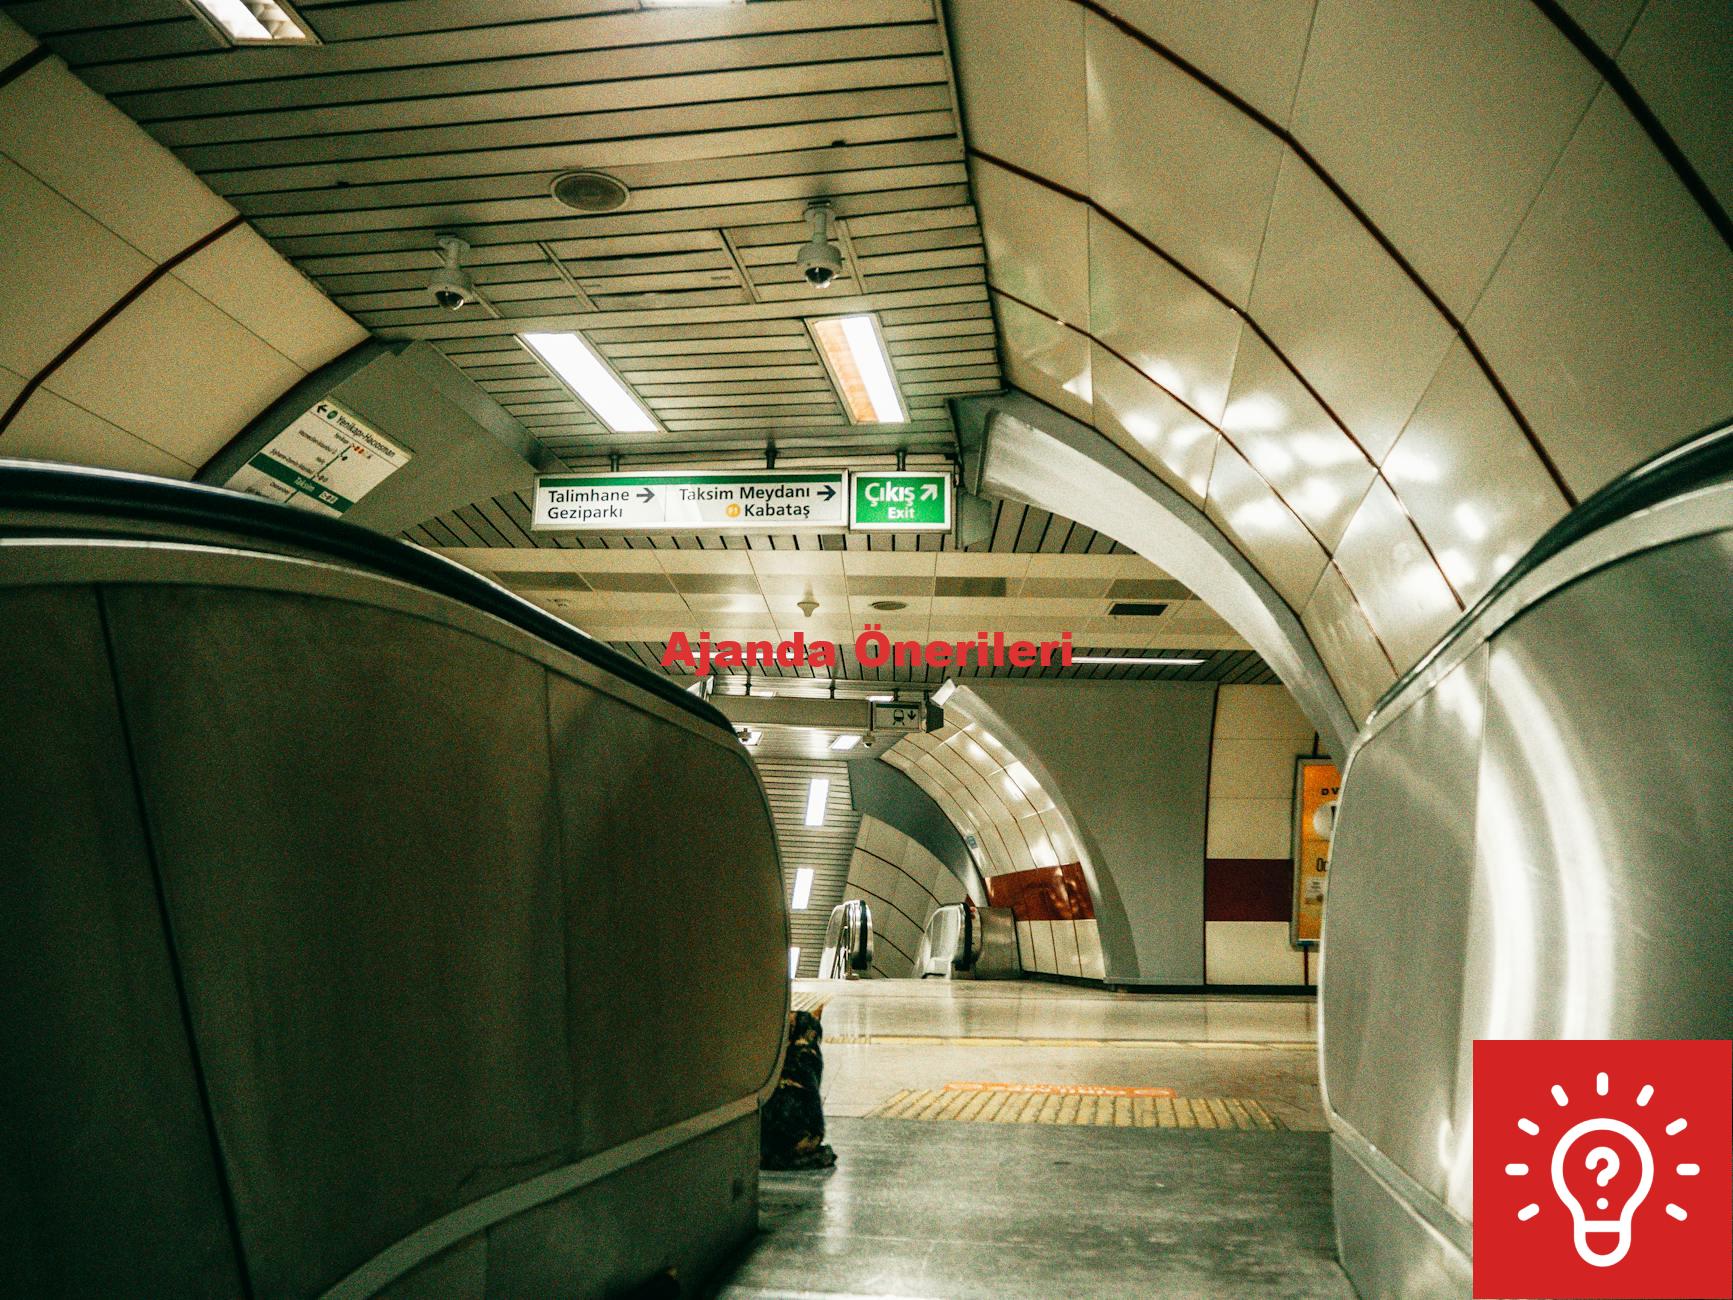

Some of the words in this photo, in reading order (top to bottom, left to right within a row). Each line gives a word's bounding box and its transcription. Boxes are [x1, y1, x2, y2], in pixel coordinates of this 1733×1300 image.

[548, 488, 630, 503] Talimhane
[679, 486, 733, 501] Taksim
[740, 484, 810, 501] Meydanı
[864, 481, 916, 507] Çıkış
[547, 505, 623, 522] Geziparkı
[744, 503, 811, 519] Kabataş
[887, 507, 915, 519] Exit
